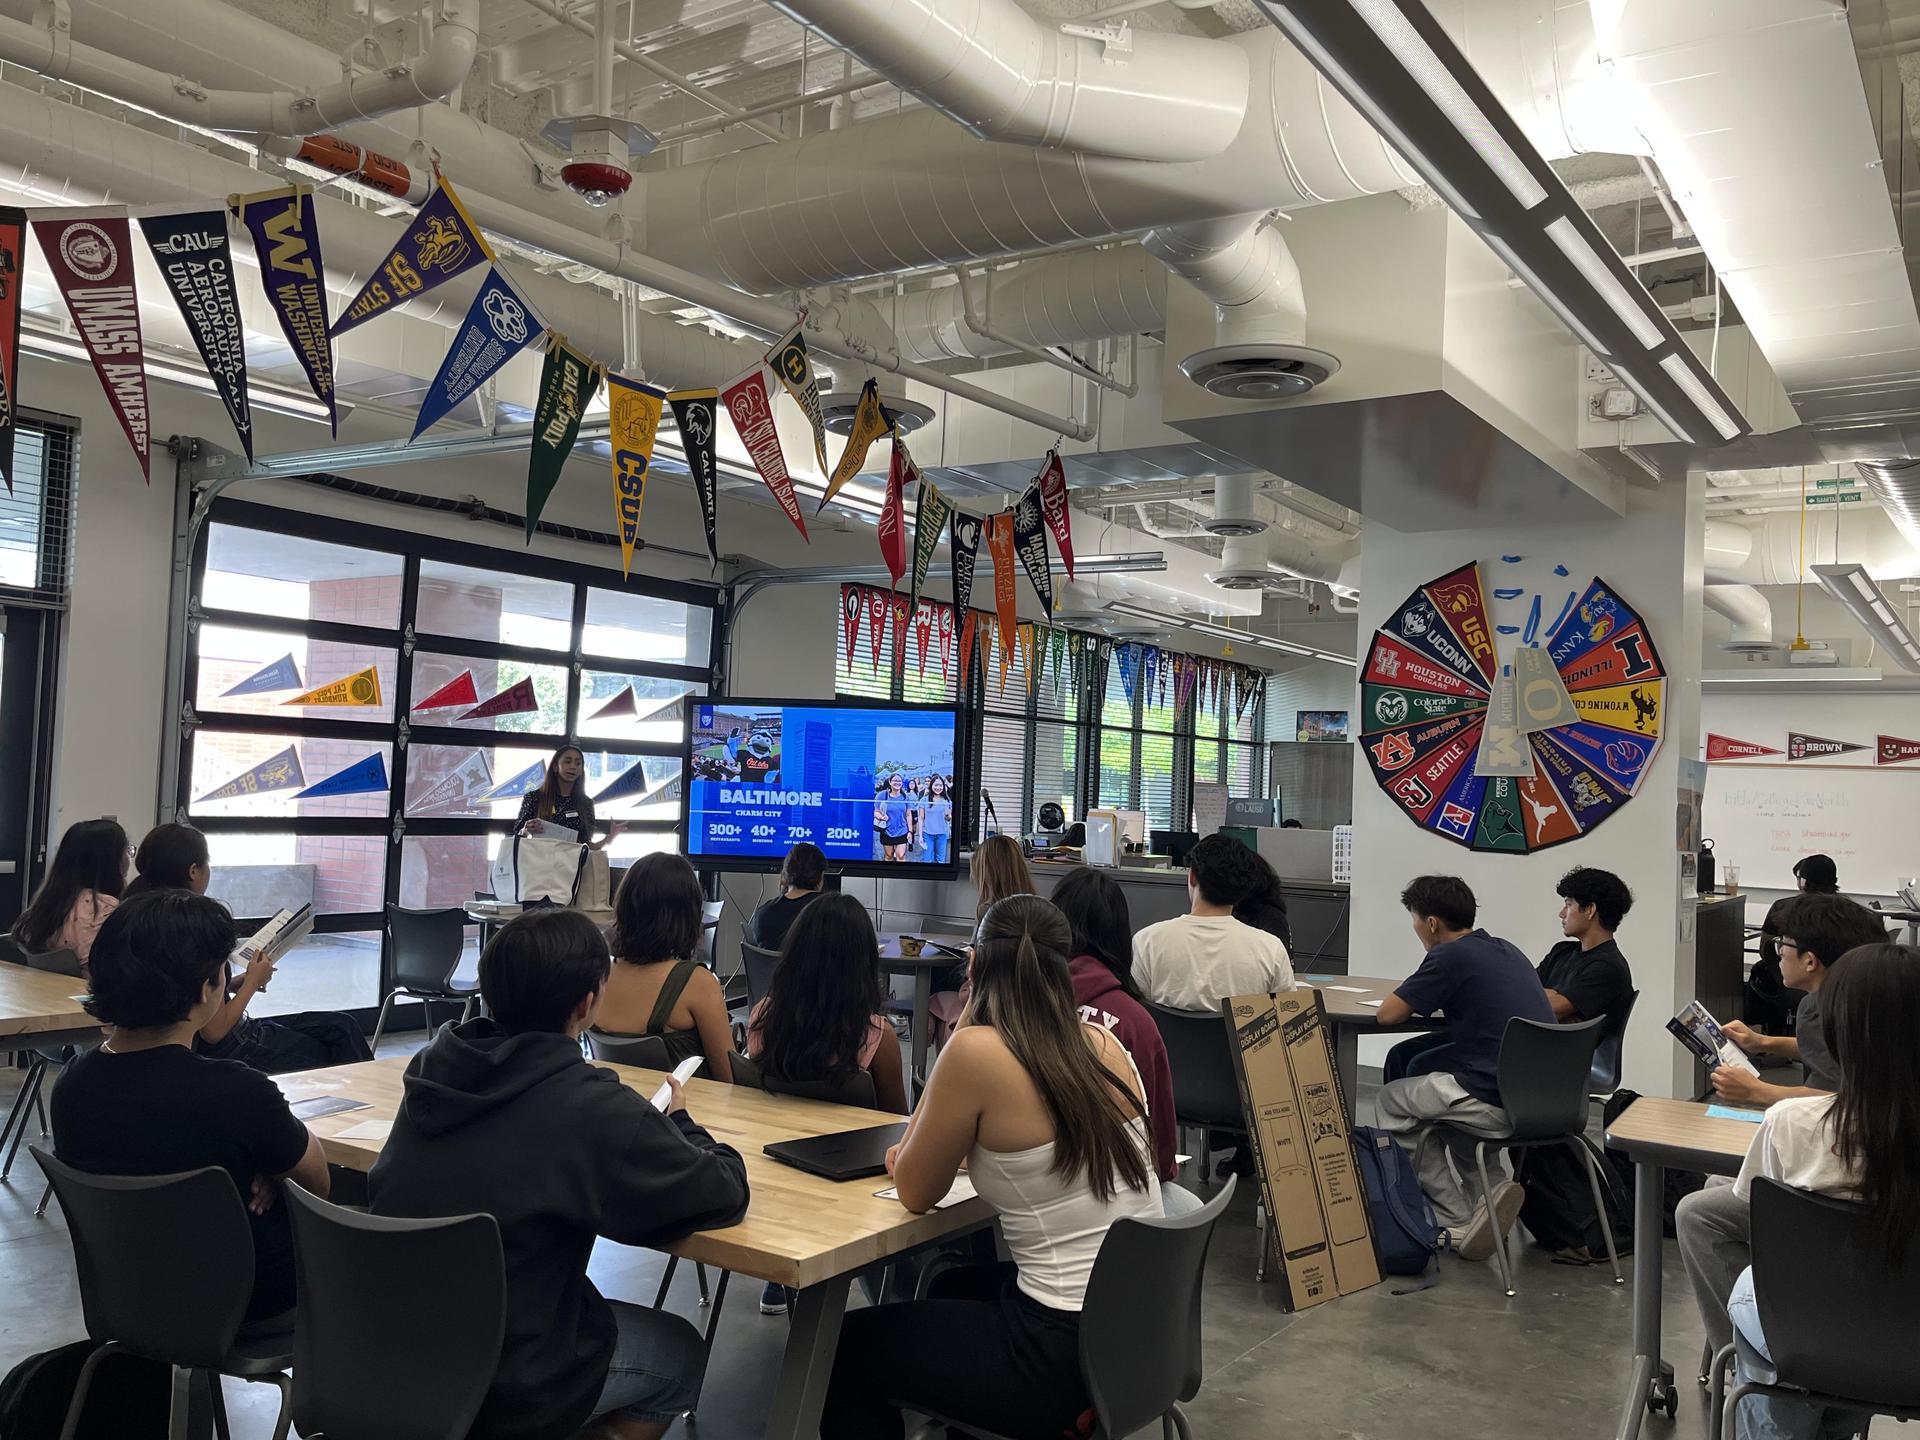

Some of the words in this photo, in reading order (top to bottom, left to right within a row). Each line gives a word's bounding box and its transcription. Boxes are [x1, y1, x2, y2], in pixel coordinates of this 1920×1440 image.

[605, 167, 626, 179] FIRE
[169, 231, 210, 253] CAU
[383, 251, 424, 298] SF
[167, 262, 225, 376] UNIVERSITY
[208, 258, 243, 374] CALIFORNIA
[348, 281, 391, 321] STATE
[67, 285, 139, 356] UMASS
[187, 261, 242, 408] AERONAUTICAL
[276, 283, 330, 394] WASHINGTON
[299, 283, 328, 372] UNIVERSITY
[444, 325, 487, 391] UNIVERSITY
[469, 338, 507, 379] SONOMA
[786, 355, 803, 377] H
[447, 370, 476, 402] STATE
[538, 369, 560, 424] MUSTANGS
[562, 359, 580, 400] CAL
[101, 362, 148, 455] AMHERST
[806, 380, 827, 452] HUMBO
[540, 411, 572, 449] POLY
[742, 418, 775, 452] CSU
[701, 450, 712, 475] CAL
[754, 434, 788, 488] CHANNEL
[614, 449, 647, 545] CSUB
[702, 478, 715, 513] STATE
[776, 482, 800, 521] ISLANDS
[1046, 489, 1070, 542] Bard
[1001, 556, 1014, 603] PITZER
[1020, 545, 1044, 592] COLLEGE
[1028, 533, 1051, 599] HAMPSHIRE
[1426, 629, 1472, 674] UCONN
[1461, 615, 1492, 660] USC
[1552, 631, 1585, 662] KANS
[1405, 661, 1461, 688] HOUSTON
[1413, 673, 1448, 690] COUGARS
[1562, 659, 1613, 687] ILLINOIS
[1413, 696, 1457, 707] Colorado
[1424, 704, 1447, 715] State
[1588, 701, 1629, 711] WYOMING
[1416, 717, 1461, 743] AUBURN
[1806, 743, 1843, 752] BROWN
[1426, 743, 1464, 781] SEATTLE
[1727, 745, 1763, 754] CORNELL
[719, 789, 823, 807] BALTIMORE
[1500, 777, 1509, 798] COU
[1577, 771, 1613, 804] JMU
[735, 809, 763, 817] CHARM
[764, 810, 782, 818] CITY
[1244, 804, 1264, 814] LAUSD
[709, 823, 742, 836] 300+
[750, 825, 776, 837] 40+
[787, 826, 813, 838] 70+
[826, 828, 860, 840] 200+
[1241, 1028, 1261, 1048] DISPLAY
[1260, 1018, 1277, 1035] BOARD
[1285, 1024, 1304, 1043] DISPLAY
[1304, 1014, 1319, 1031] BOARD
